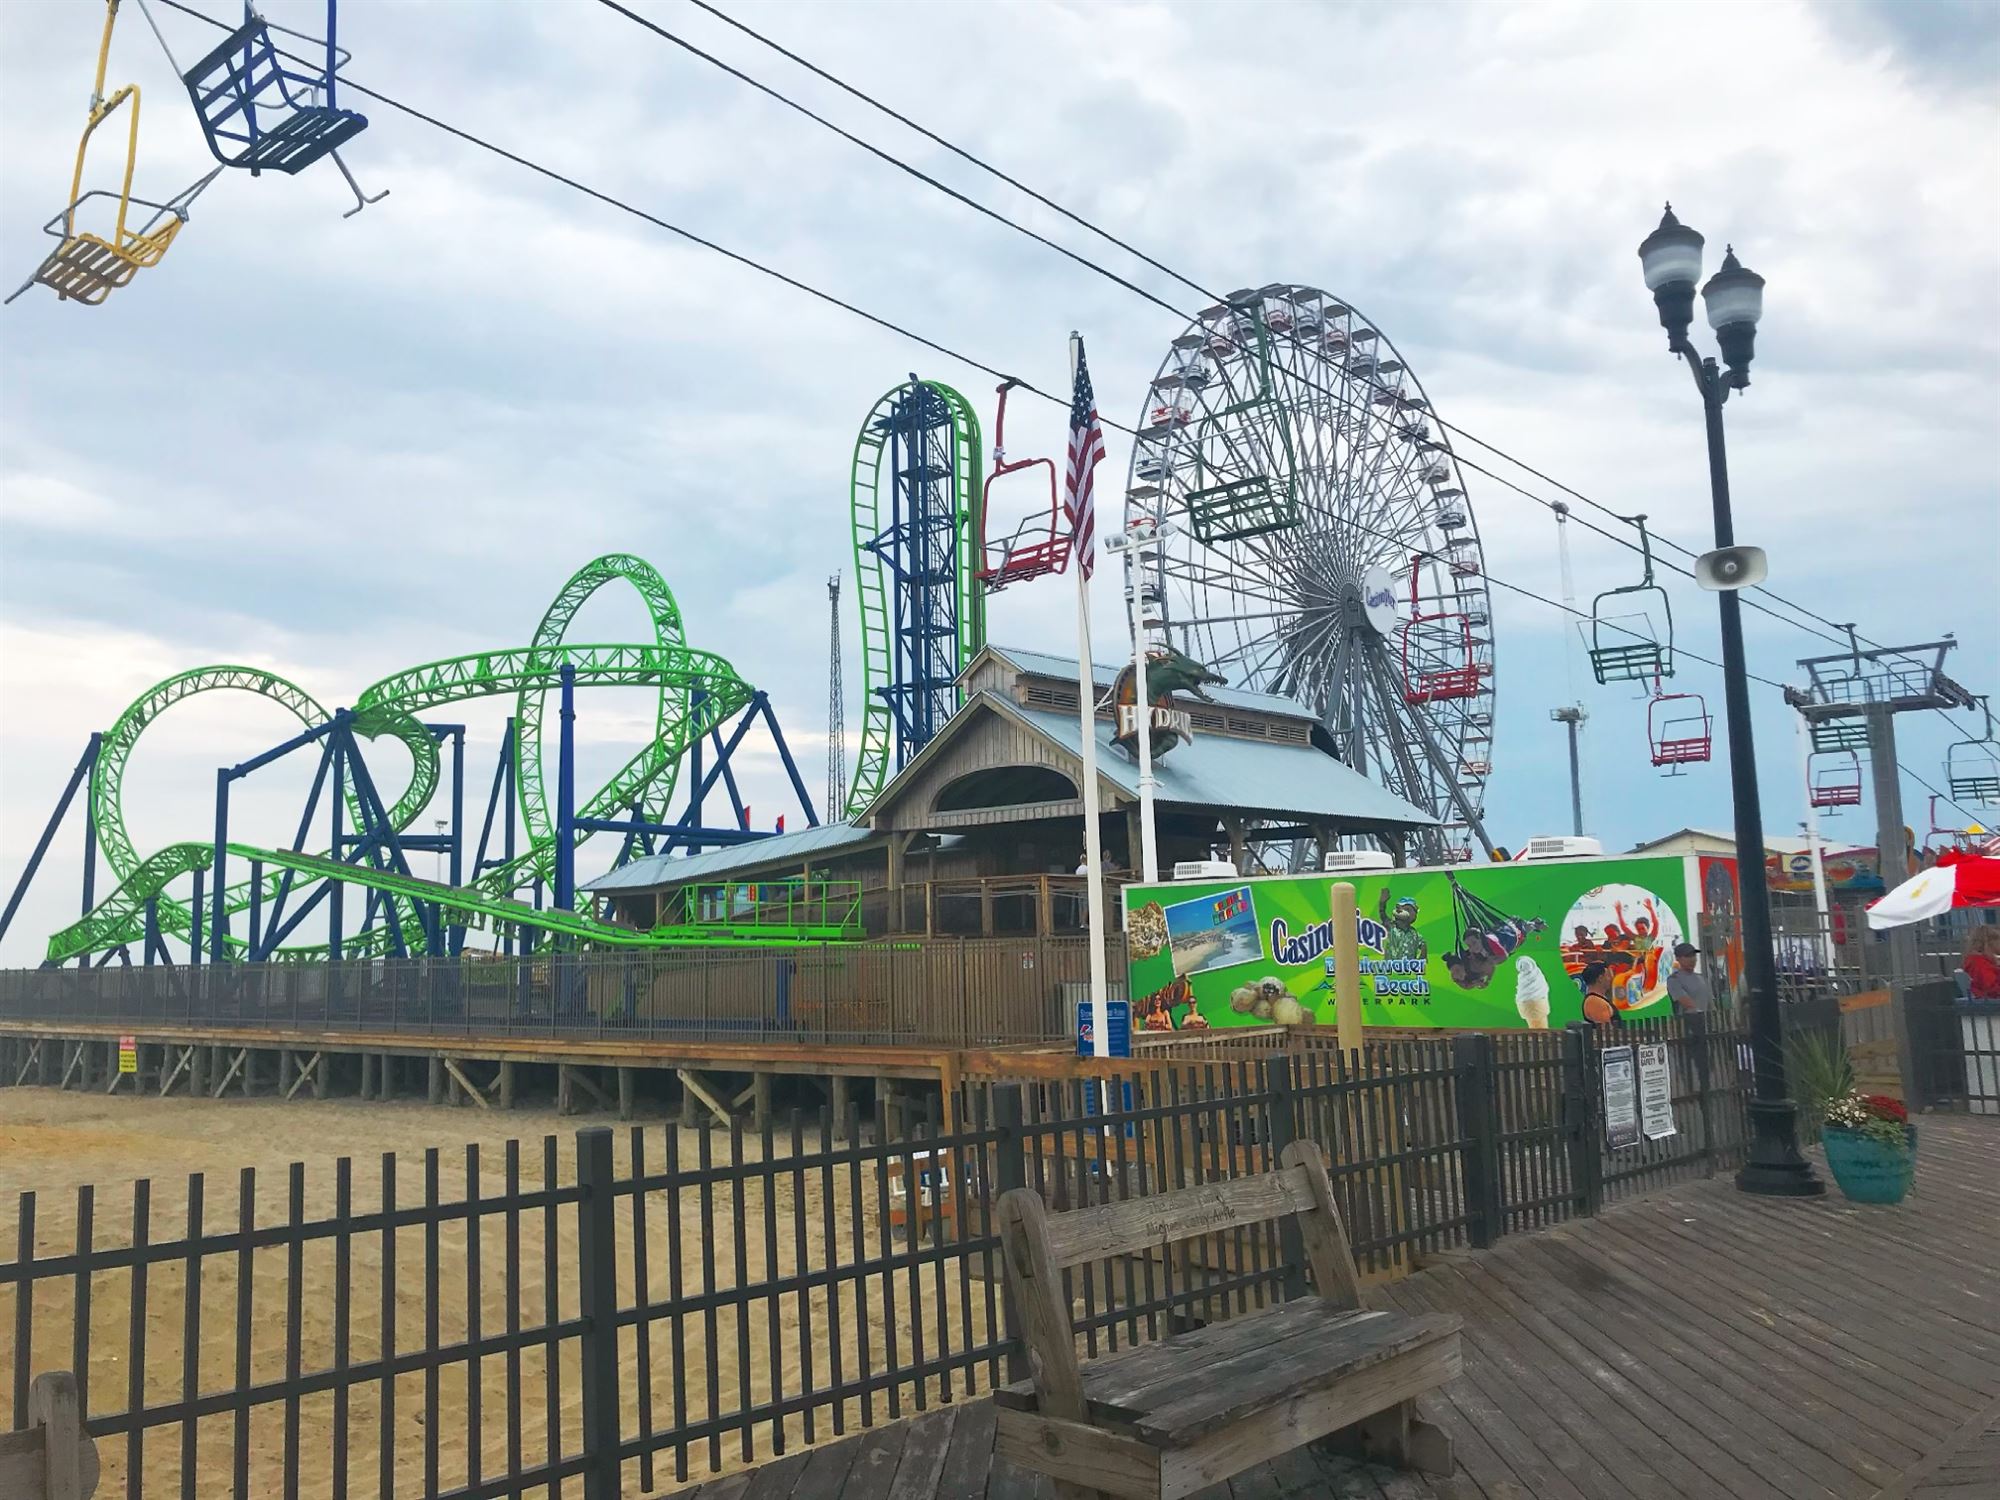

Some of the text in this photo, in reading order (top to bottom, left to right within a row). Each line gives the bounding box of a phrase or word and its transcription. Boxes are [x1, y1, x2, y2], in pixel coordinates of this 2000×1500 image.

[1355, 908, 1387, 954] ier
[1325, 956, 1427, 975] Bkwater
[1374, 975, 1430, 996] Beach
[1327, 998, 1431, 1006] WERPARK
